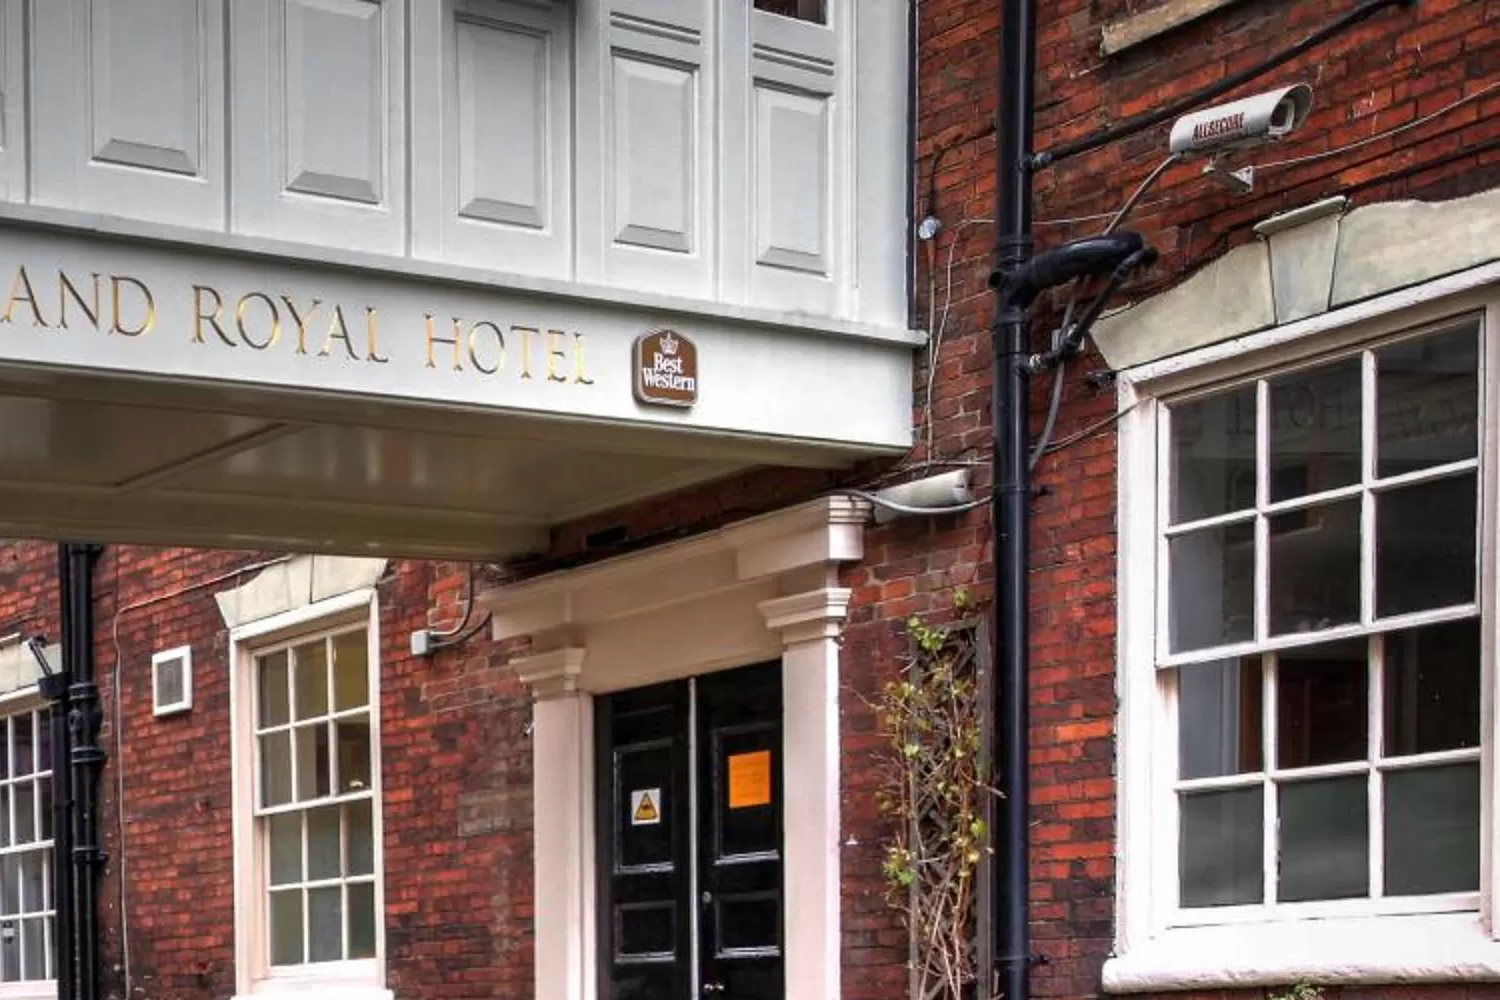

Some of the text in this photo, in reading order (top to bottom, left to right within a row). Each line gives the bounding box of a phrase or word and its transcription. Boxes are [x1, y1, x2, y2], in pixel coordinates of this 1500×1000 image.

[0, 265, 155, 337] AND
[190, 285, 389, 364] ROYAL
[425, 313, 595, 385] HOTEL
[653, 351, 684, 374] Best
[643, 367, 695, 391] Western
